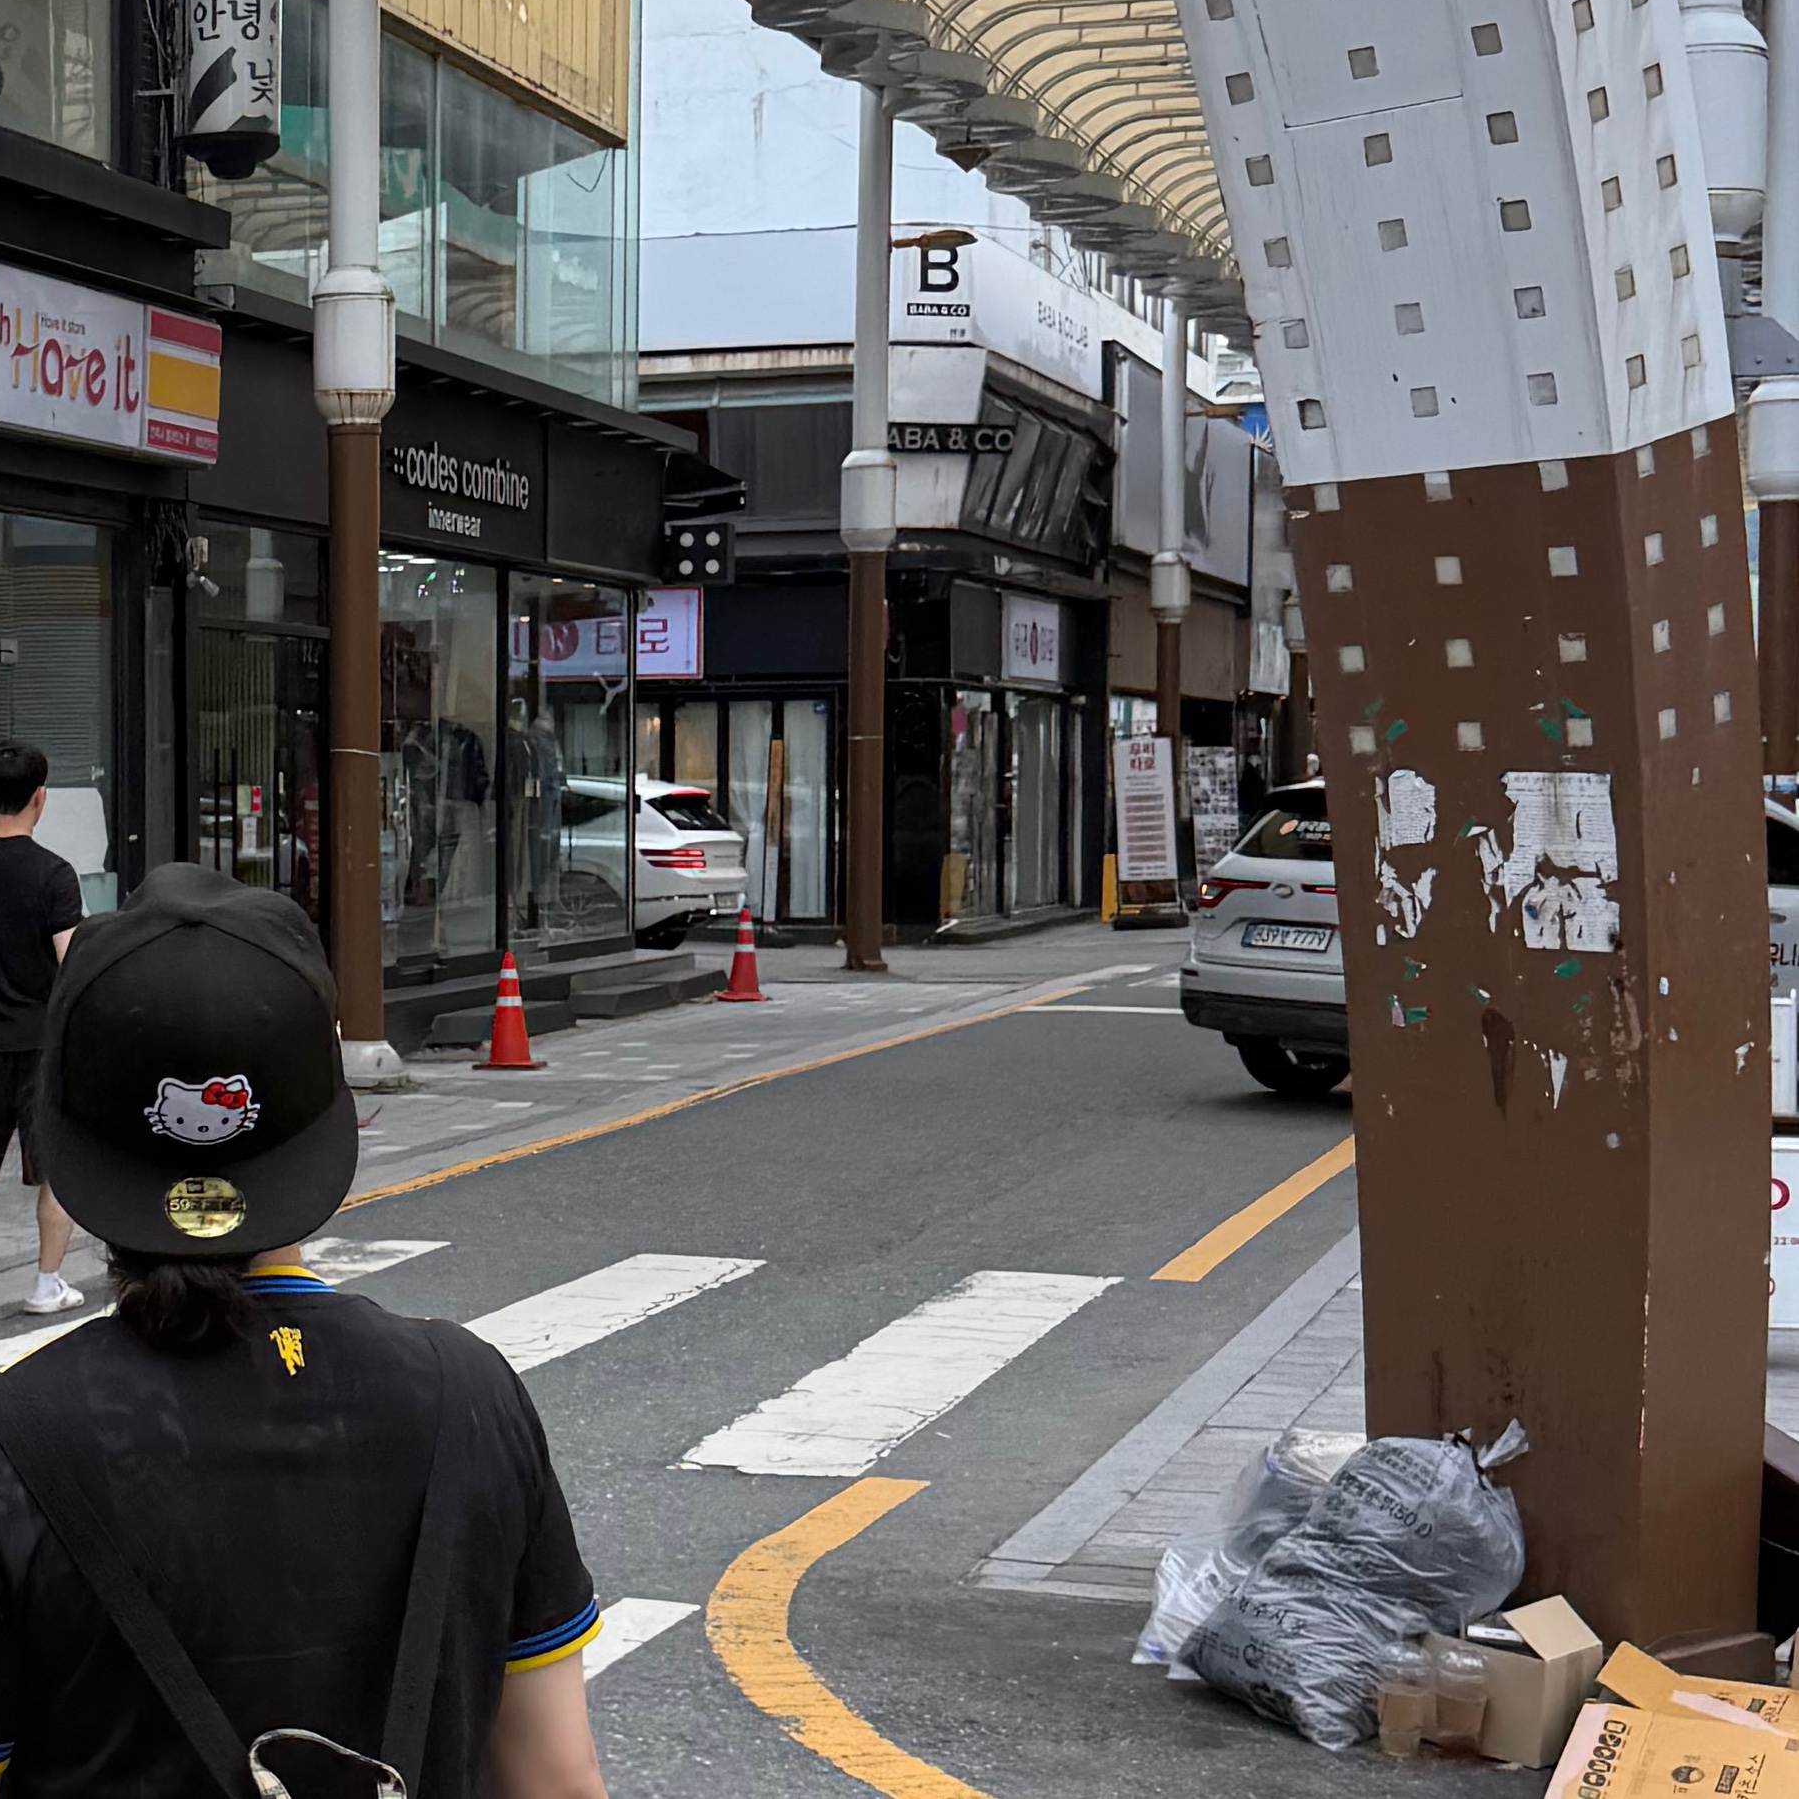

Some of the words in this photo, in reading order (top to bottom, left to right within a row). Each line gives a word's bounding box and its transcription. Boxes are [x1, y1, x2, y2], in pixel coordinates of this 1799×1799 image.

[919, 246, 960, 293] B
[11, 307, 106, 407] Have
[113, 334, 140, 414] it
[888, 427, 940, 450] ABA
[950, 428, 967, 450] &
[974, 428, 1014, 451] CO
[406, 440, 459, 495] codes
[461, 457, 530, 511] combine
